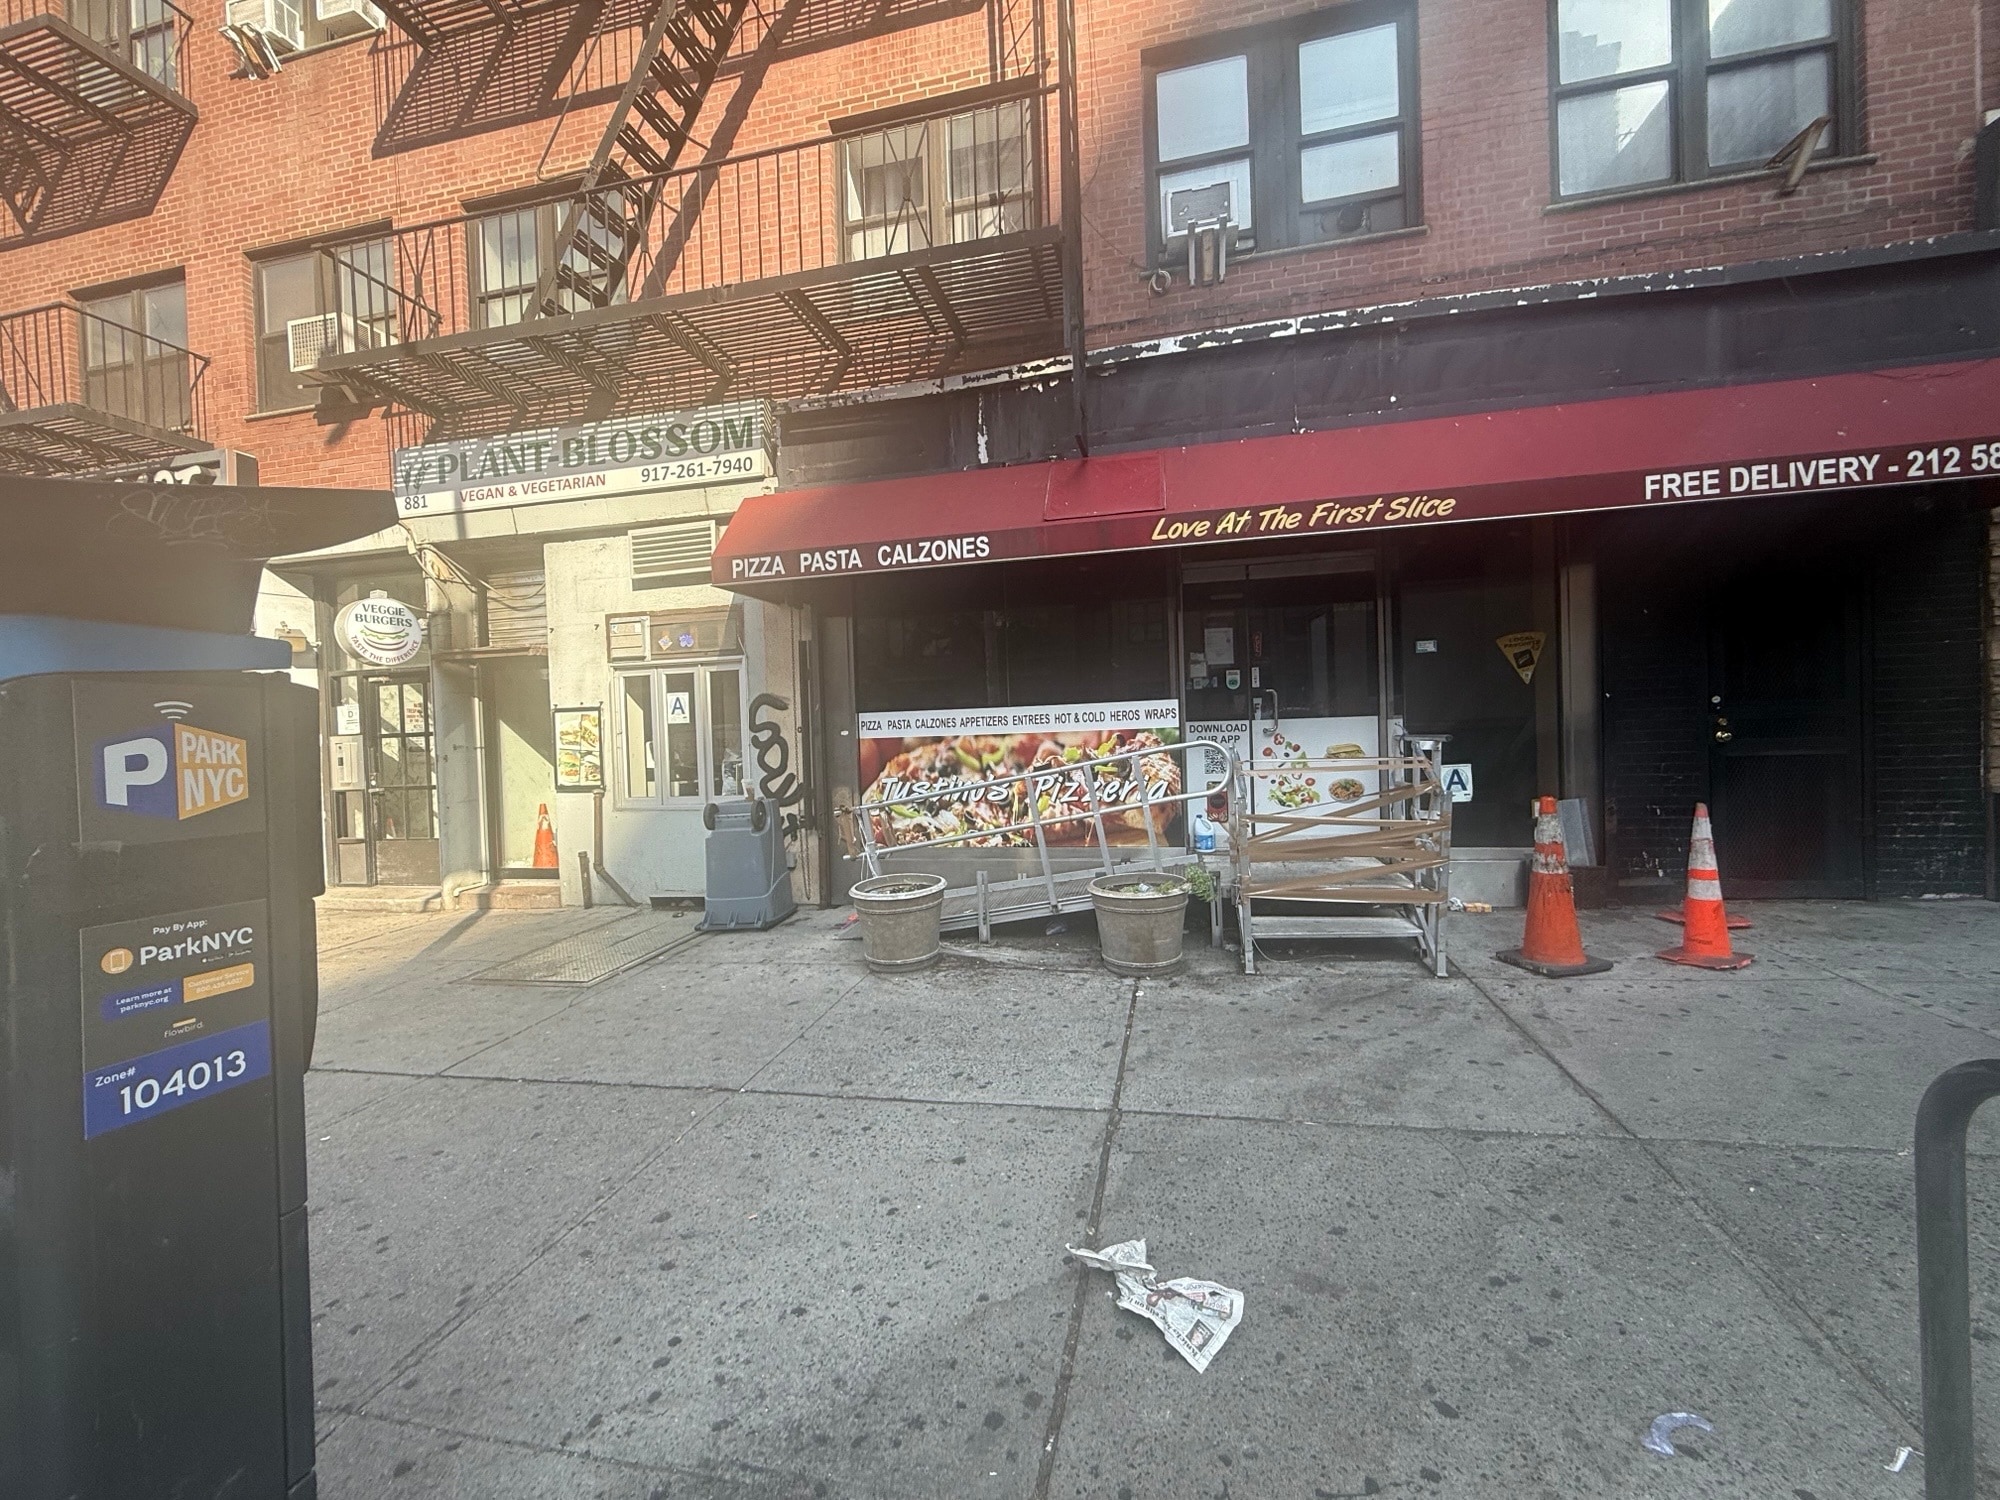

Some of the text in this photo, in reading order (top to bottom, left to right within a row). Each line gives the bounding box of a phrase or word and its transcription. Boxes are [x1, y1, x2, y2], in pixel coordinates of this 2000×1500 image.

[438, 416, 754, 485] PLANT-BLOSSOM
[641, 456, 753, 482] 917-261-7940
[1645, 469, 1720, 500] FREE
[1730, 454, 1881, 493] DELIVERY
[1906, 446, 1961, 477] 212
[460, 474, 606, 502] VEGAN & VEGETARIAN
[404, 495, 428, 510] 881
[1152, 496, 1457, 541] Love At The First Slice
[732, 535, 990, 578] PIZZA PASTA CALZONES
[355, 613, 412, 627] BURGERS
[362, 603, 405, 616] VEGGIE
[351, 635, 419, 663] TASTE THE DIFFERENCE
[671, 696, 685, 715] A
[861, 708, 1177, 731] PIZZA PASTA CALZONES APPETIZERS ENTREES HOT & COLD HEROS WRAPS
[1189, 723, 1248, 734] DOWNLOAD
[181, 731, 242, 766] PARK
[1220, 735, 1241, 744] APP
[103, 737, 168, 806] P
[1446, 768, 1467, 791] A
[183, 767, 246, 811] NYC
[153, 919, 208, 935] Pay By App:
[140, 927, 253, 966] ParkNYC
[116, 995, 140, 1006] Learn
[141, 990, 162, 1000] more
[120, 995, 169, 1013] parknyc.org
[95, 1065, 136, 1088] Zone#
[120, 1049, 246, 1115] 104013
